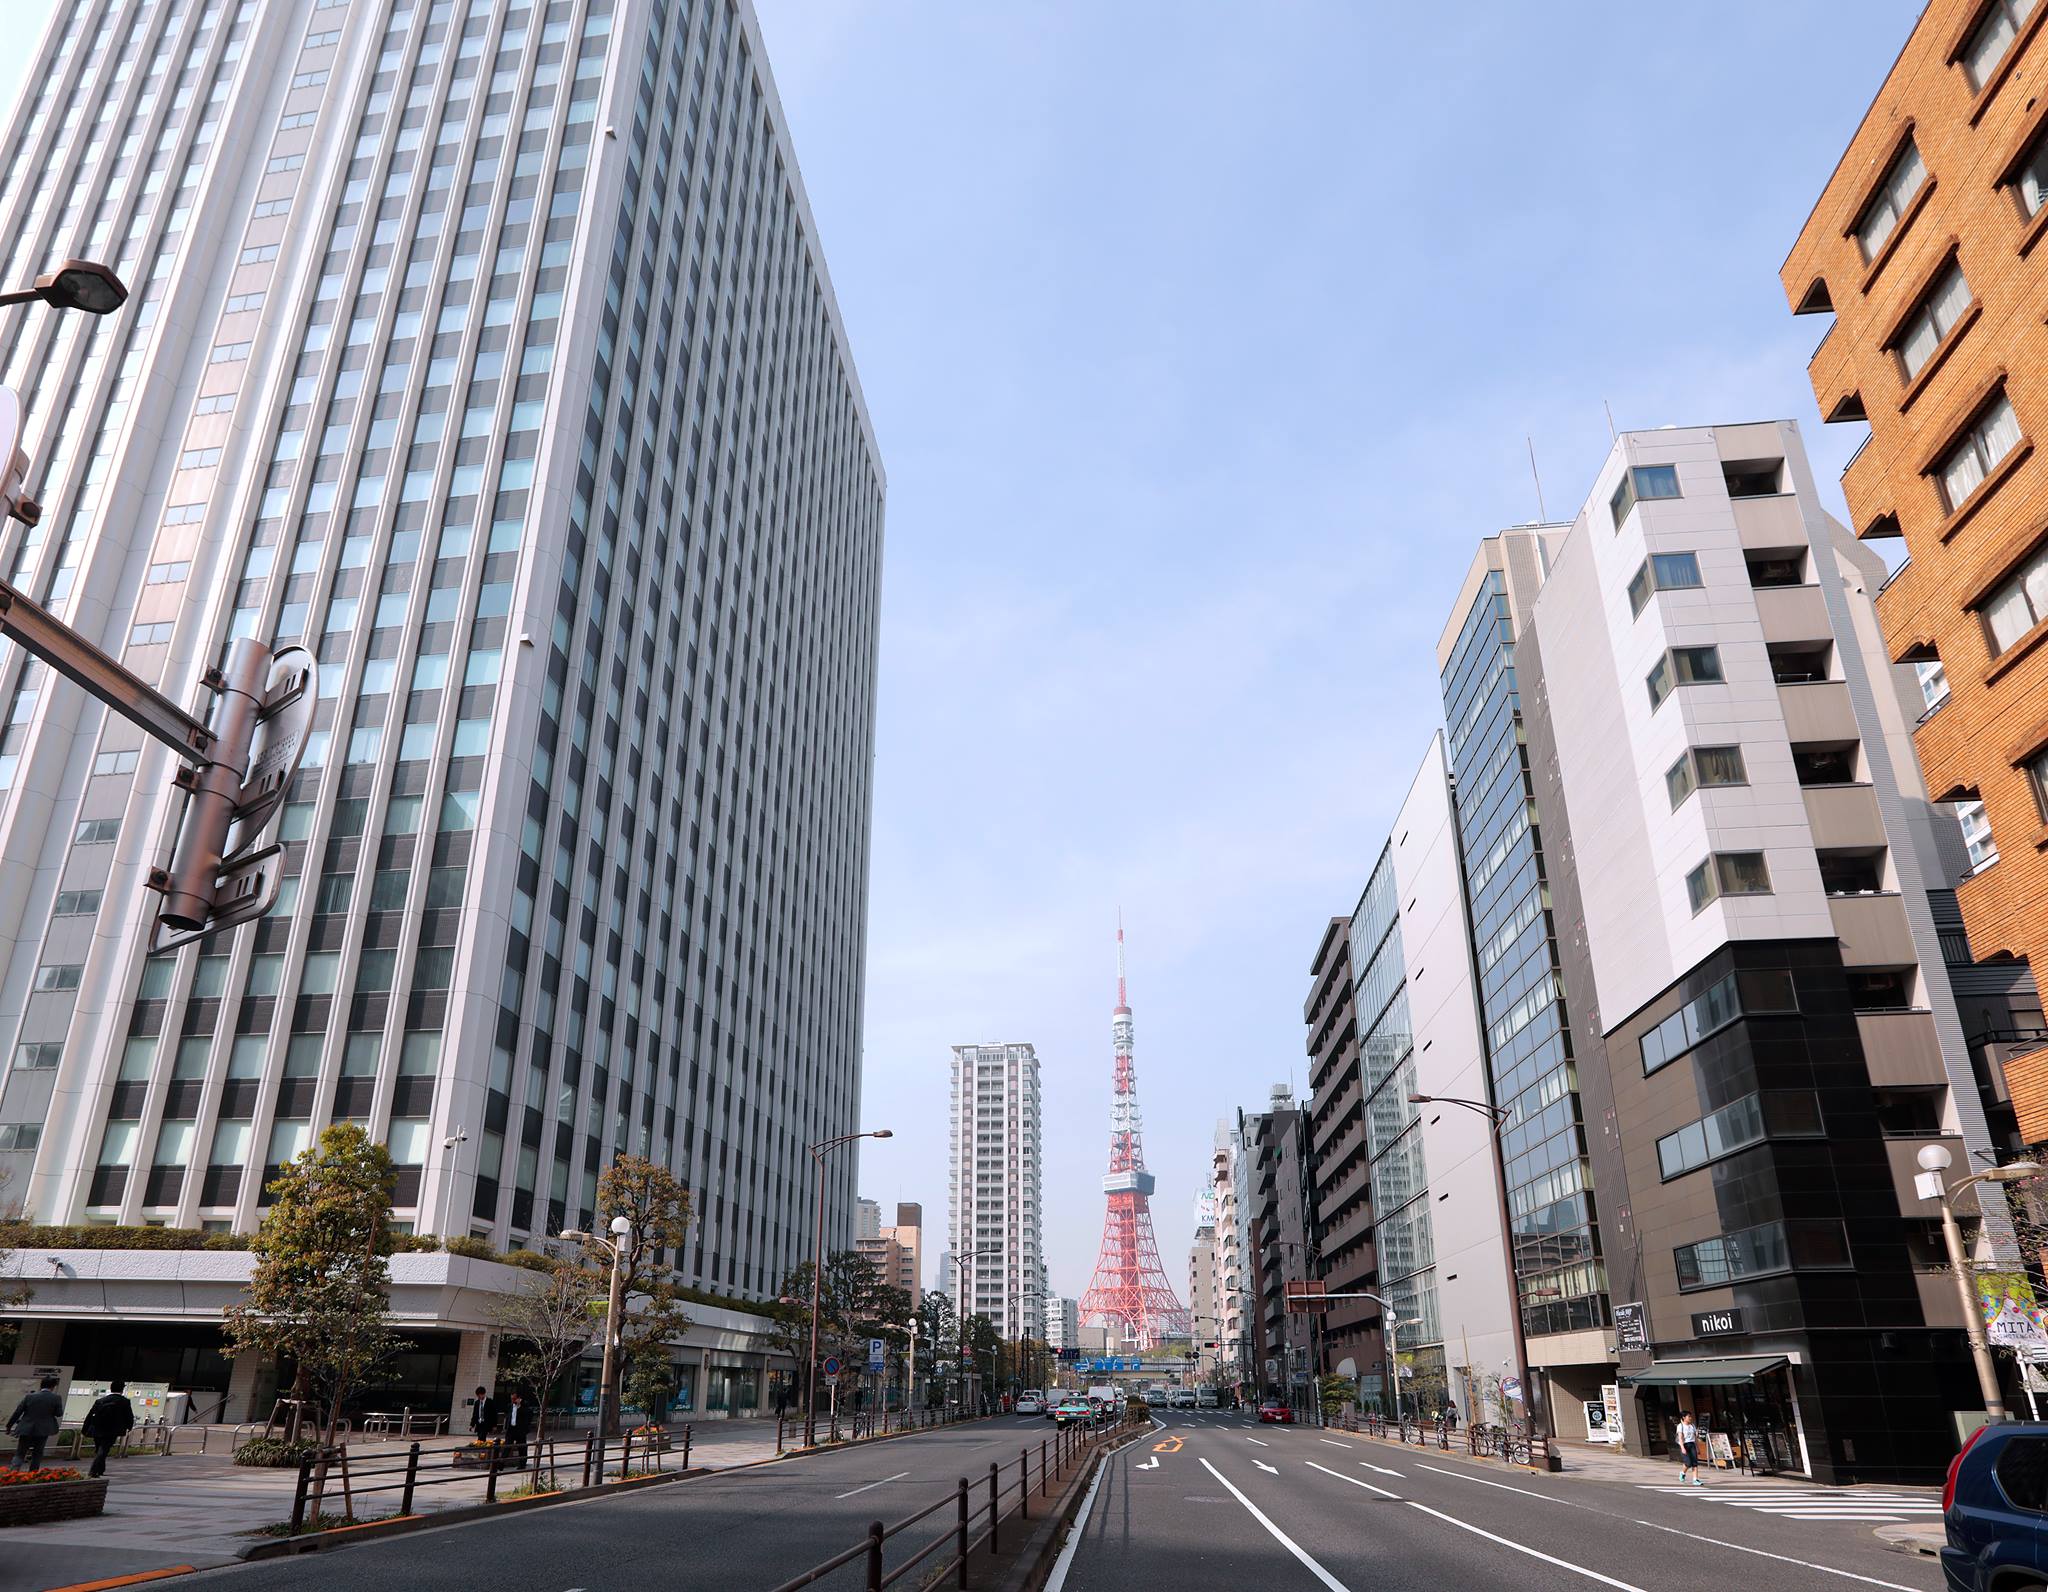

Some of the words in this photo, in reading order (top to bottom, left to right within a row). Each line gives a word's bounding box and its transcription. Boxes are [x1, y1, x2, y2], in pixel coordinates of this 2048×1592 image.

[1701, 1312, 1733, 1332] nikoi
[1996, 1322, 2035, 1334] MITA
[872, 1341, 882, 1352] P
